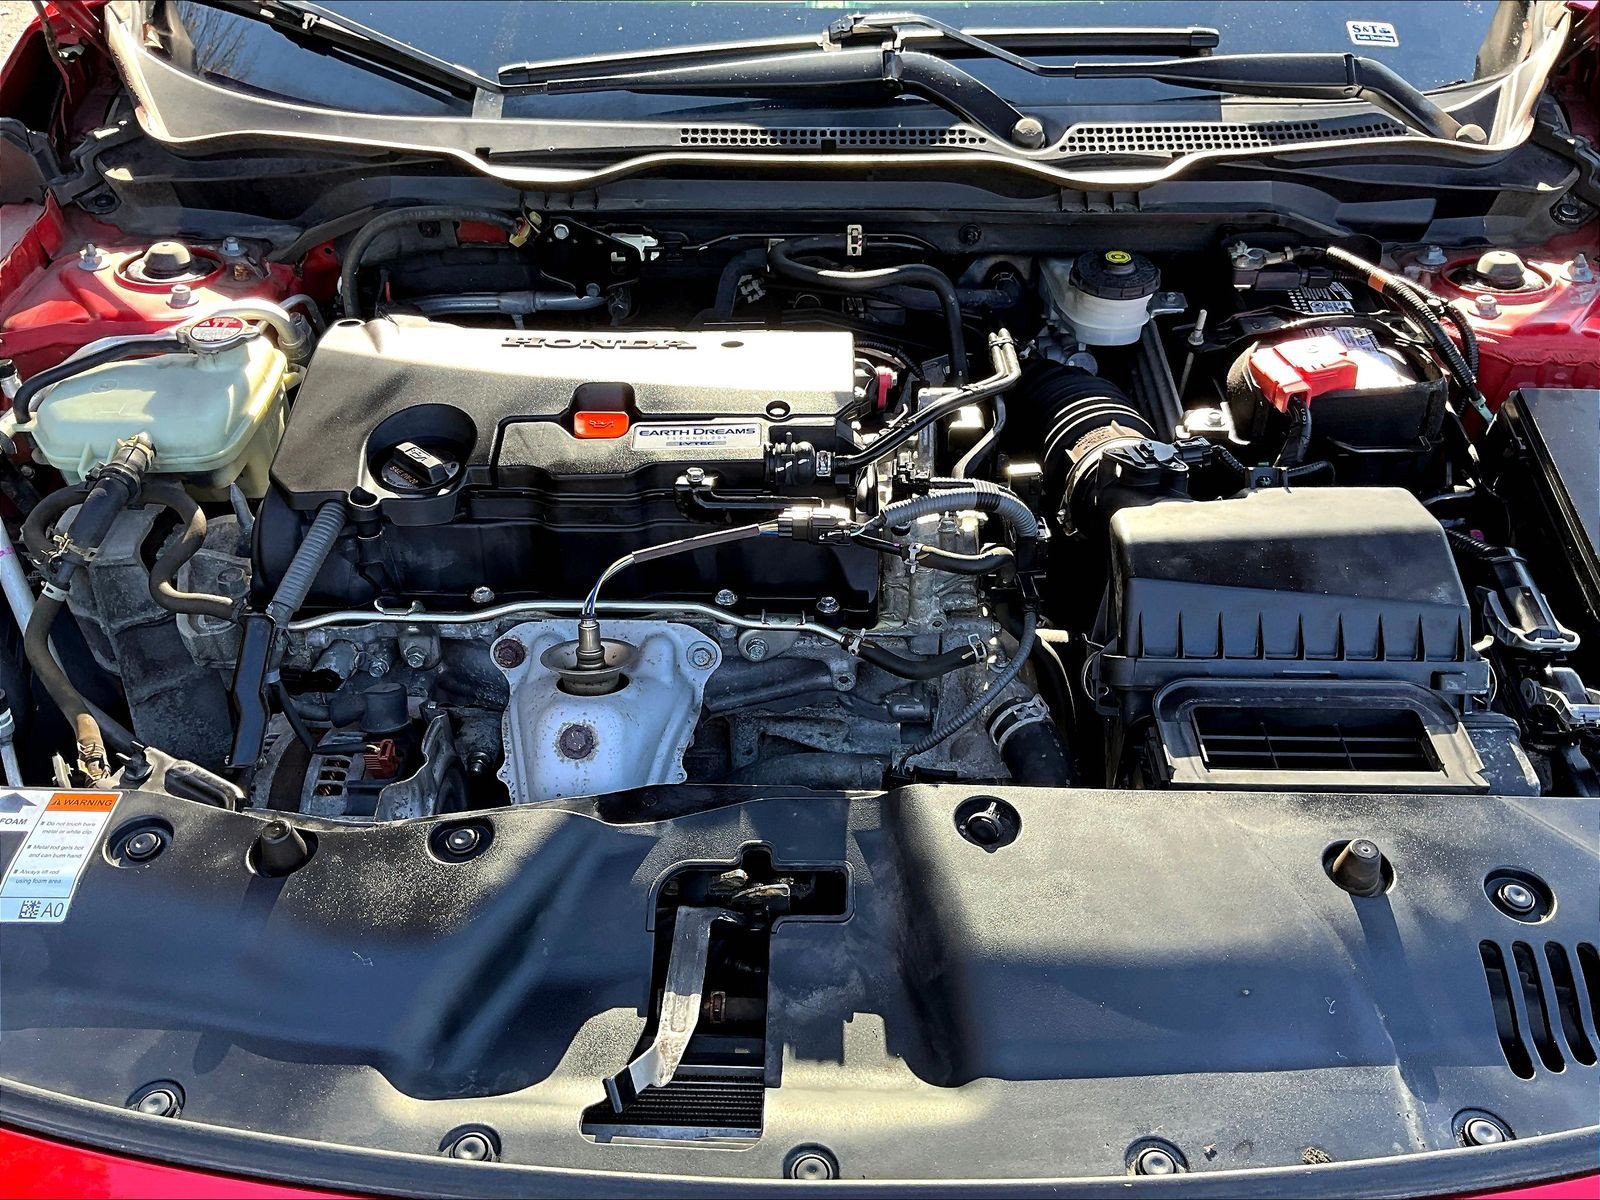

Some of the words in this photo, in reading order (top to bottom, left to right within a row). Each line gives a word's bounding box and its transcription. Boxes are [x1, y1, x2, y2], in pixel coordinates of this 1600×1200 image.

[501, 337, 697, 350] HONDA
[63, 799, 112, 807] WARNING
[40, 902, 64, 918] A0
